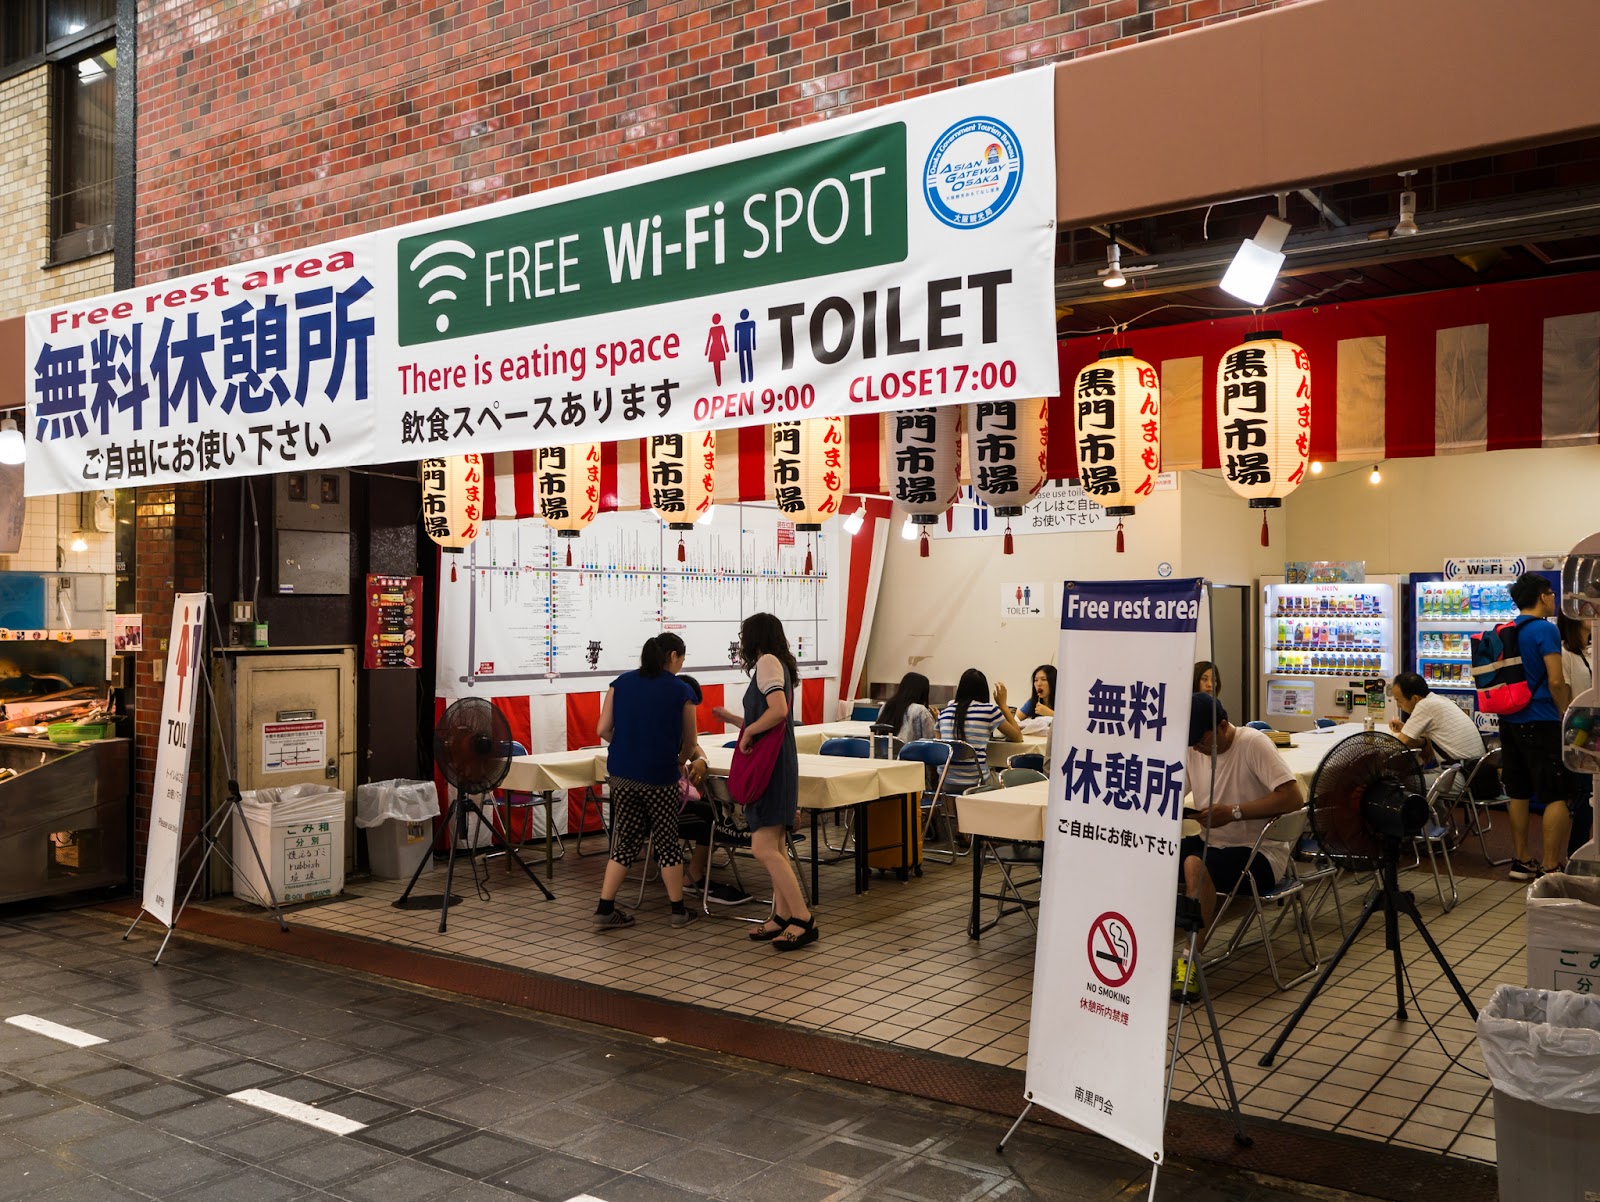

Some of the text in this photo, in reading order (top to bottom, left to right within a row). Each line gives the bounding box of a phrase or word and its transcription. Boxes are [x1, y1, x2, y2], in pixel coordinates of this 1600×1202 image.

[977, 122, 1002, 138] Tourism
[485, 166, 887, 307] FREE Wi-Fi SPOT
[50, 250, 355, 334] Free rest area
[768, 268, 1013, 370] TOILET
[34, 275, 375, 443] 無料休憩所
[398, 331, 681, 395] There is eating space
[401, 378, 681, 444] 飲食スペースあります
[693, 383, 816, 421] OPEN 9:00
[1078, 367, 1121, 496] 黒門市場
[1134, 366, 1159, 496] ほんまもん
[1223, 348, 1271, 486] 黒門市場
[82, 420, 332, 481] ご自由にお使い下さい
[773, 420, 806, 513] 門市場
[817, 415, 842, 514] んまもん
[895, 406, 937, 504] 門市場
[1023, 499, 1104, 514] トイレはご自由
[1032, 512, 1100, 528] お使い下さい
[1052, 489, 1067, 498] use
[1467, 564, 1503, 575] Wi-Fi
[1007, 606, 1030, 615] TOILET
[1067, 594, 1199, 620] Free rest area
[1086, 678, 1167, 742] 無料
[1061, 746, 1184, 822] 休憩所
[289, 859, 320, 871] rubbish
[1057, 818, 1178, 857] ご自由にお使い下さい
[1080, 997, 1130, 1026] 休憩所内禁煙
[1086, 982, 1131, 1005] NO SMOKING
[1074, 1085, 1114, 1116] 南黒門会
